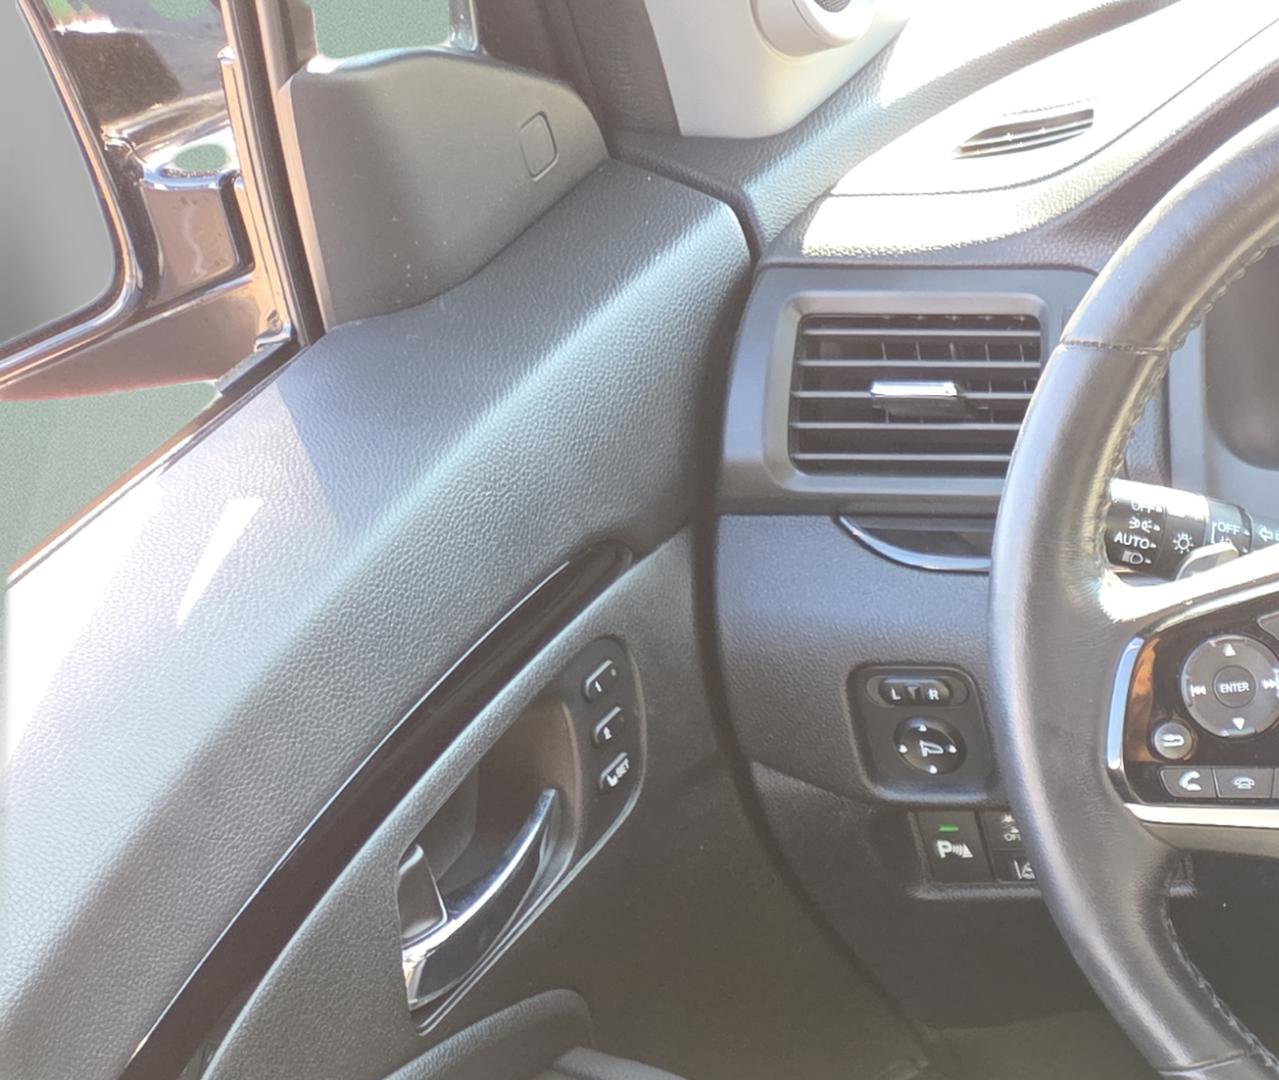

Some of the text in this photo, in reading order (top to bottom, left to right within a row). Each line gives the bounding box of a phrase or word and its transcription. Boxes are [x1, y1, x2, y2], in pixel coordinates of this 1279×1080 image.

[1217, 522, 1240, 534] OFF
[1114, 532, 1150, 549] AUTO
[1220, 681, 1250, 692] ENTER
[892, 688, 901, 700] L
[929, 688, 939, 700] R
